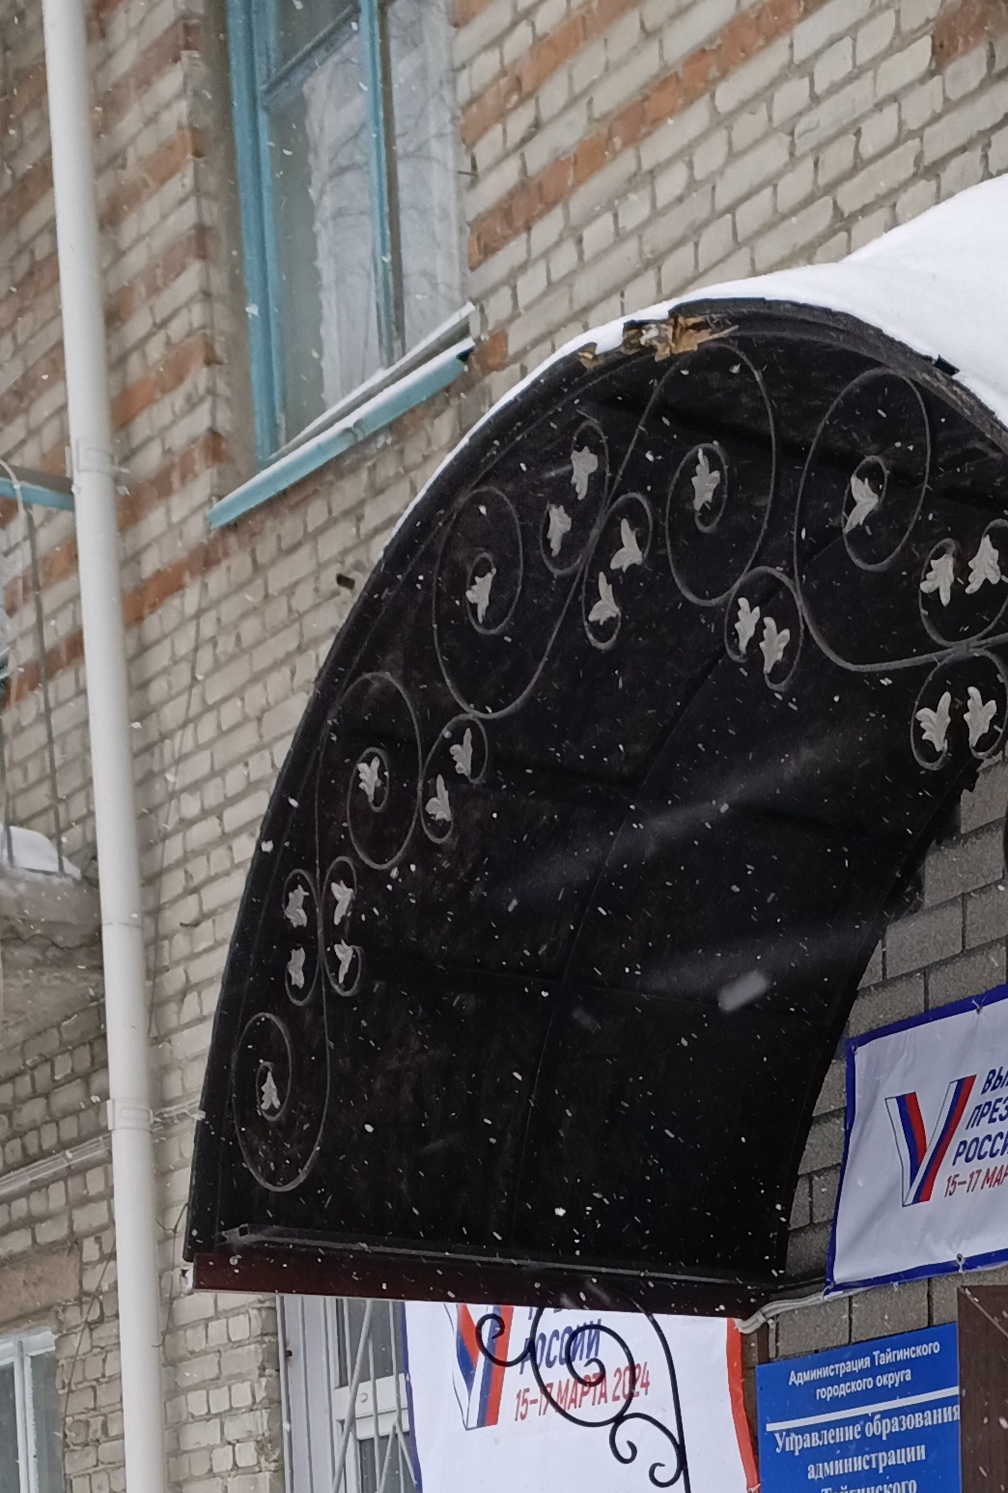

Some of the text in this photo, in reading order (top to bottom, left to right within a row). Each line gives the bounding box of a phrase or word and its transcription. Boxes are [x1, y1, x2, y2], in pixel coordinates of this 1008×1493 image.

[518, 1318, 602, 1375] РОССИИ
[789, 1340, 941, 1386] Администрация Тайгинского
[555, 1371, 608, 1413] МАРТА
[611, 1361, 651, 1402] 2024
[816, 1366, 912, 1401] городского округа
[773, 1403, 960, 1456] Управление образования
[807, 1444, 926, 1481] администрации
